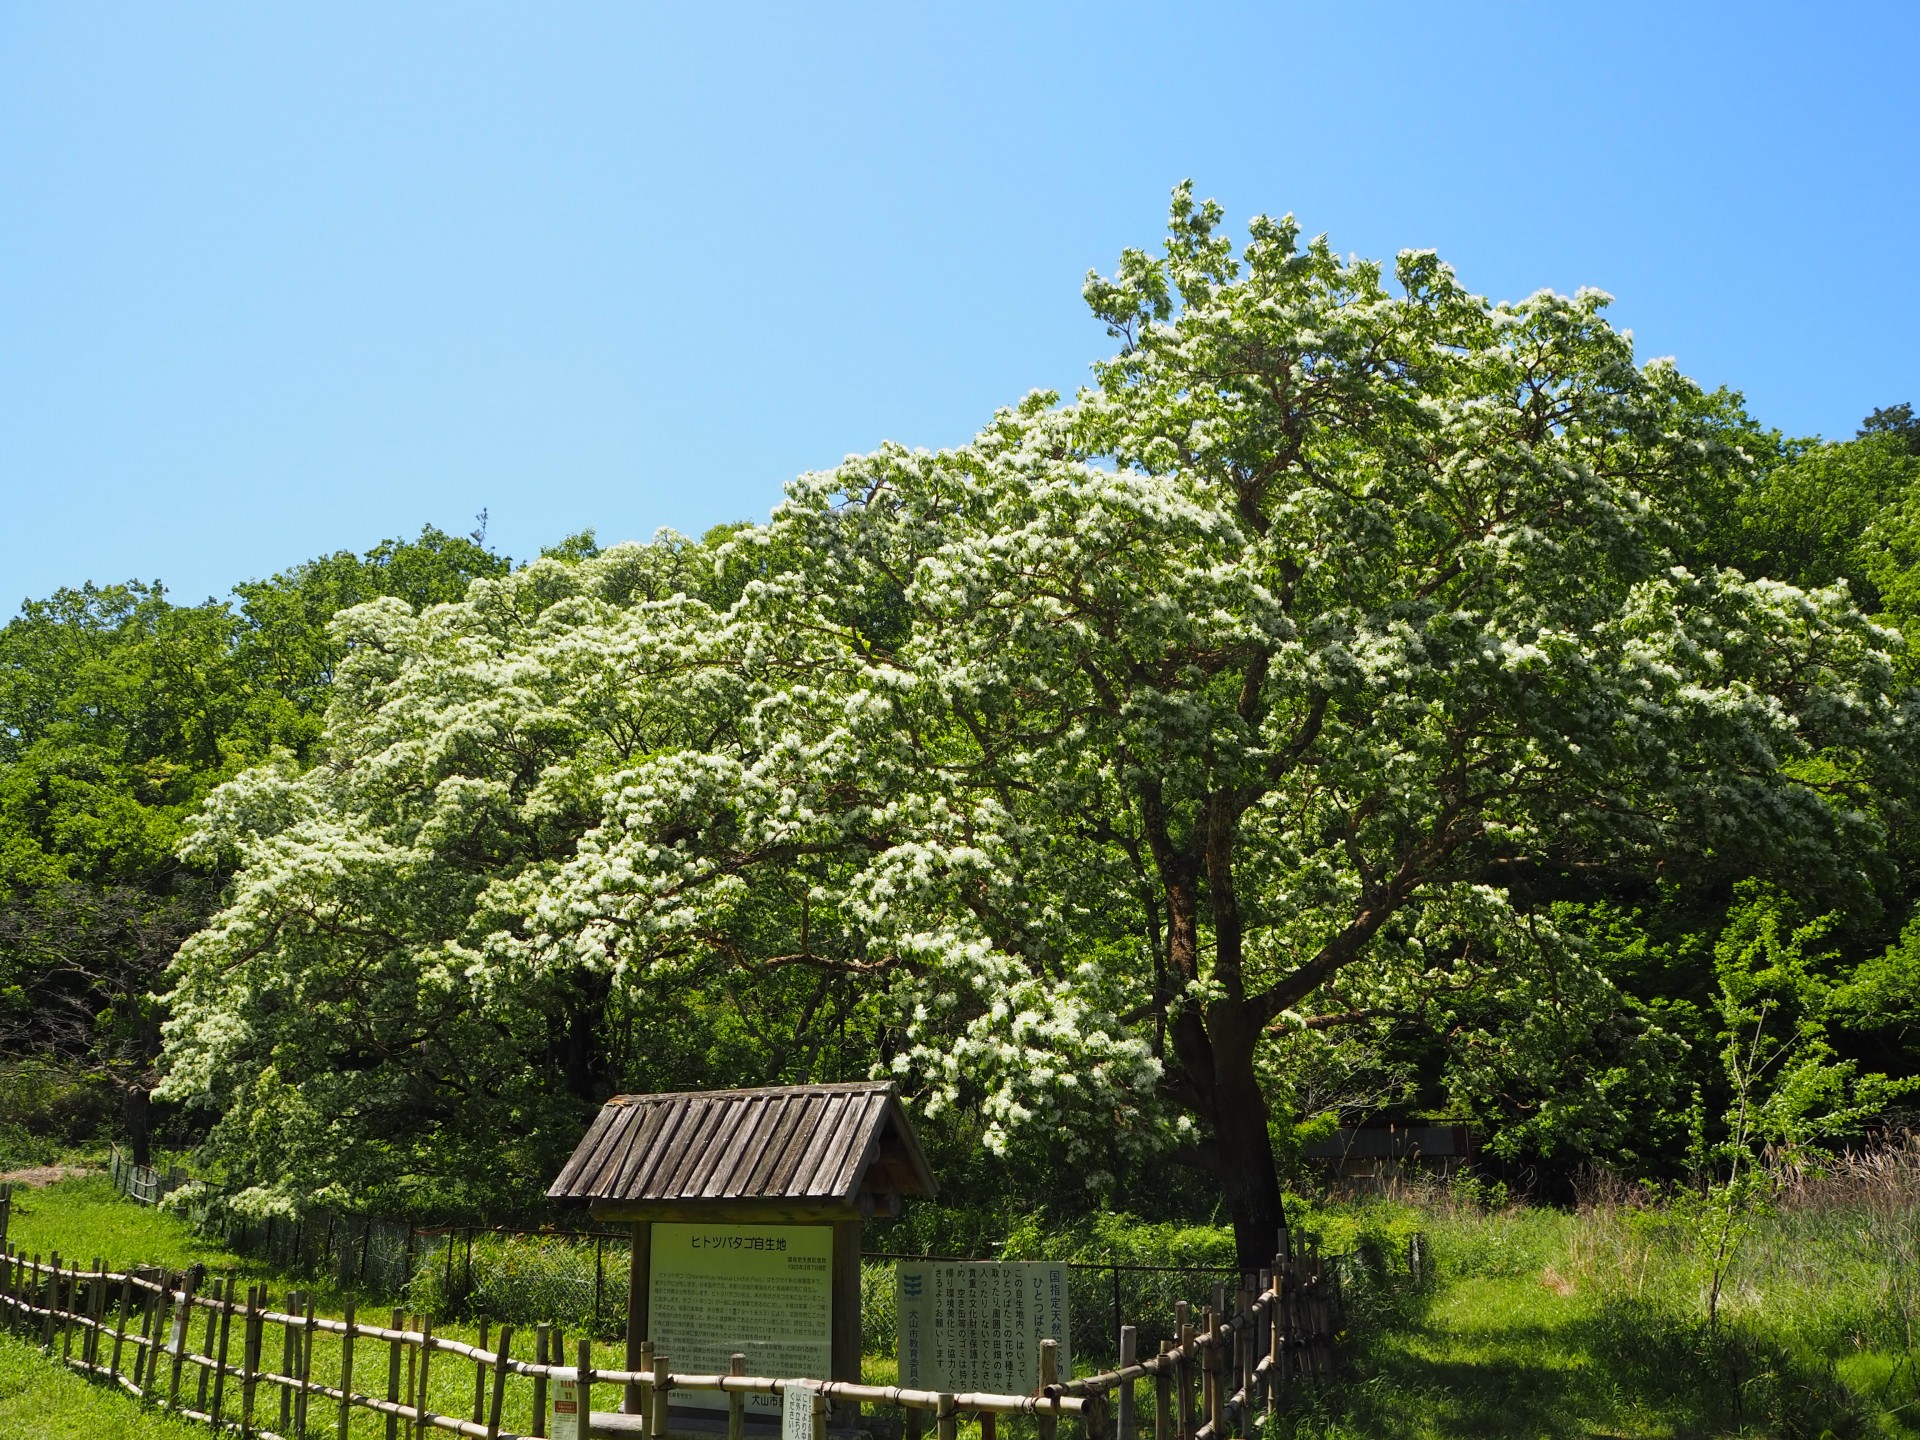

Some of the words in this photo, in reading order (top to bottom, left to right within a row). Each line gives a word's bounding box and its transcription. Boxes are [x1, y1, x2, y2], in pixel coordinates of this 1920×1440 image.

[691, 1235, 787, 1251] ヒトツバタゴ自生地
[908, 1309, 920, 1387] 犬山市教育委員会
[935, 1268, 945, 1373] さるようお願いします。
[946, 1268, 957, 1390] 帰り環境美化にご協力くだ
[957, 1269, 968, 1390] め、空き缶等のゴミは持ち
[968, 1268, 979, 1390] 貴重な文化財を保護するた
[991, 1268, 1003, 1390] 取ったり、周囲の田畑の中へ
[1014, 1269, 1027, 1383] この自生地内へはいって、
